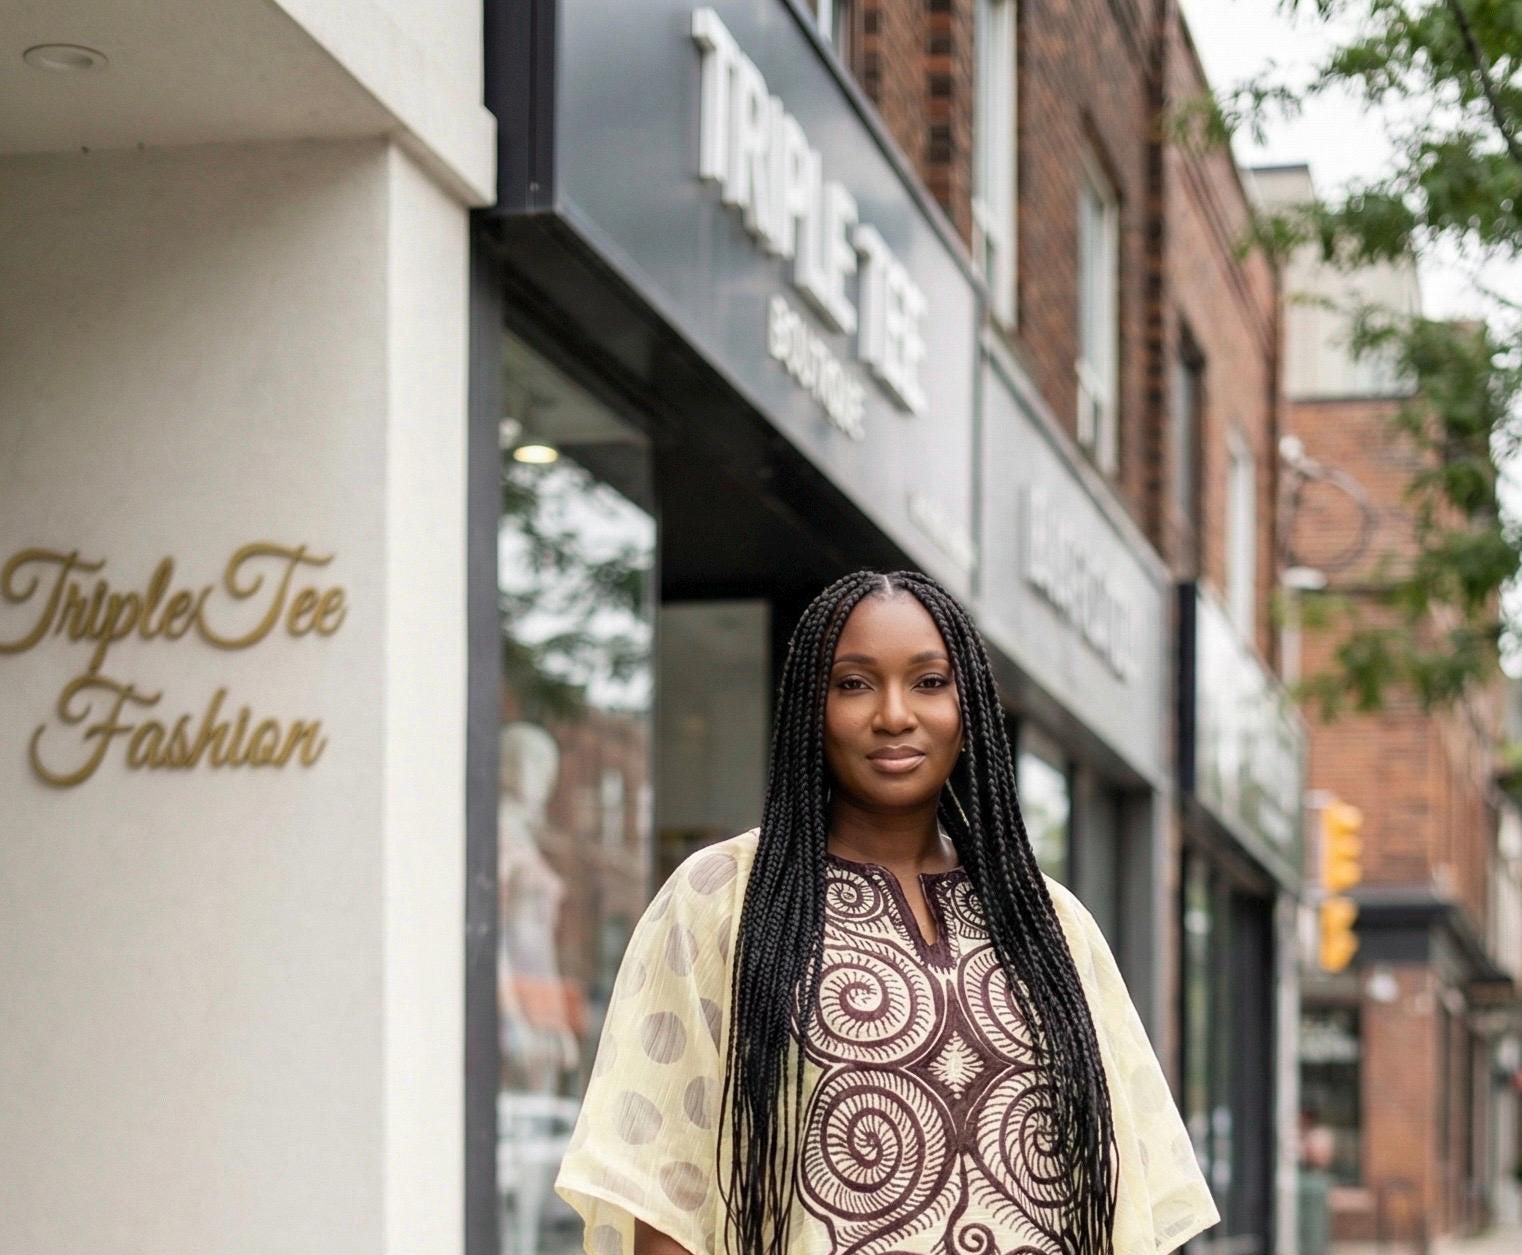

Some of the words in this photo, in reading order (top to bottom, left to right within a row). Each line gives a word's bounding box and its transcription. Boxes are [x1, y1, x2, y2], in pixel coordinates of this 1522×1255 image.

[692, 6, 858, 336] TRIPLE
[853, 222, 928, 419] TEE
[0, 547, 208, 677] Triple
[196, 540, 346, 652] Tee
[28, 674, 327, 788] Fashion
